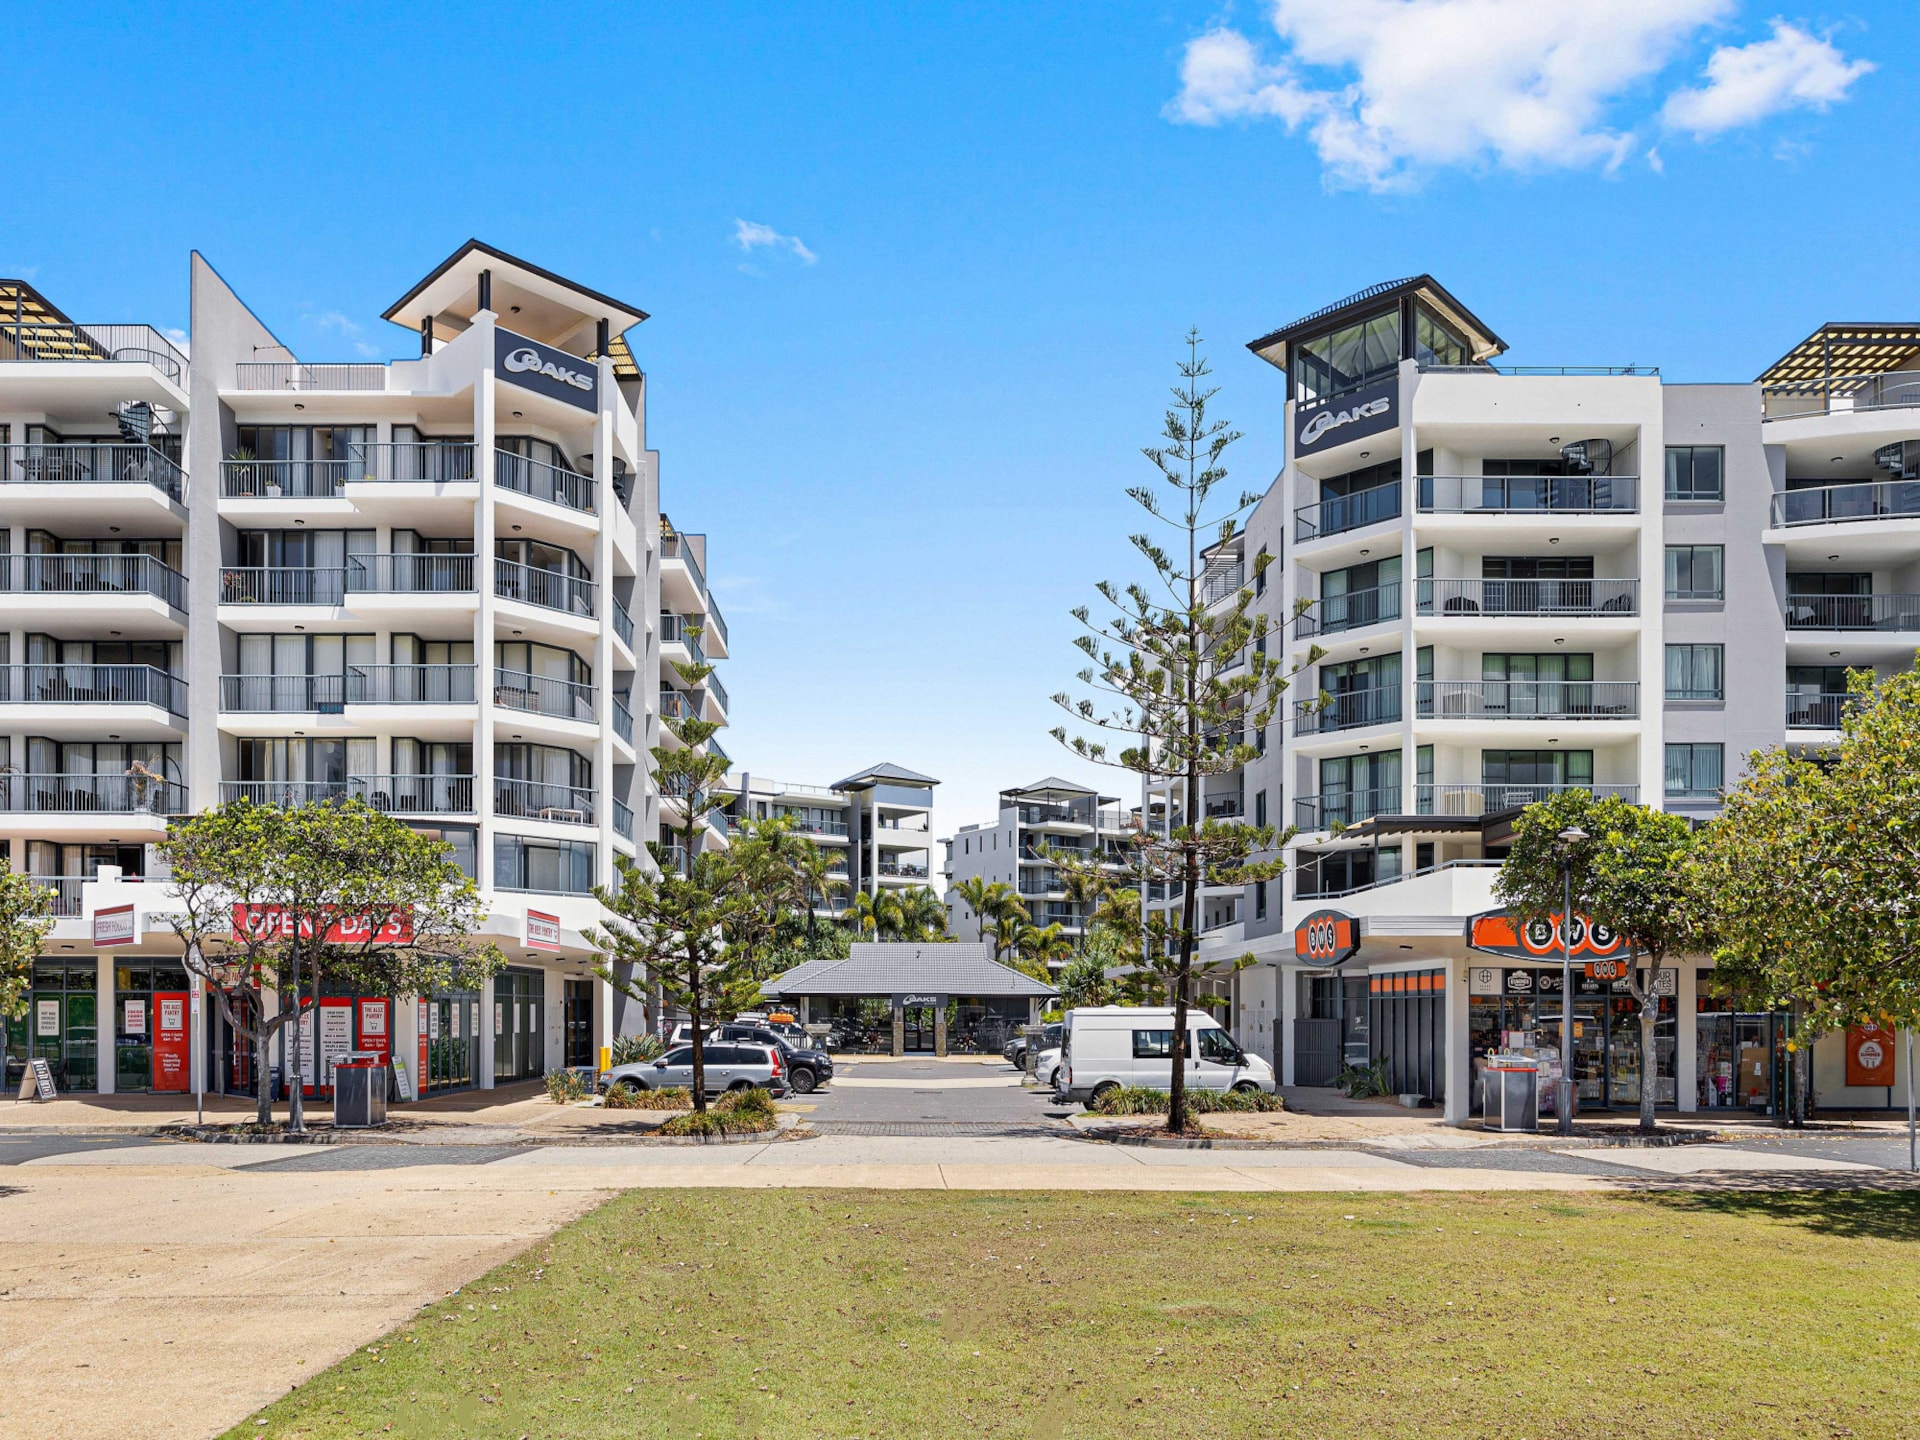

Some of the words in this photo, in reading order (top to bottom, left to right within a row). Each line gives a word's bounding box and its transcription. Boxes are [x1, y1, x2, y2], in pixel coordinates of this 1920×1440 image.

[503, 347, 593, 391] OAKS
[1300, 396, 1390, 445] OAKS
[96, 920, 111, 934] FRESH
[245, 912, 313, 935] OPEN
[902, 994, 937, 1006] OAKS
